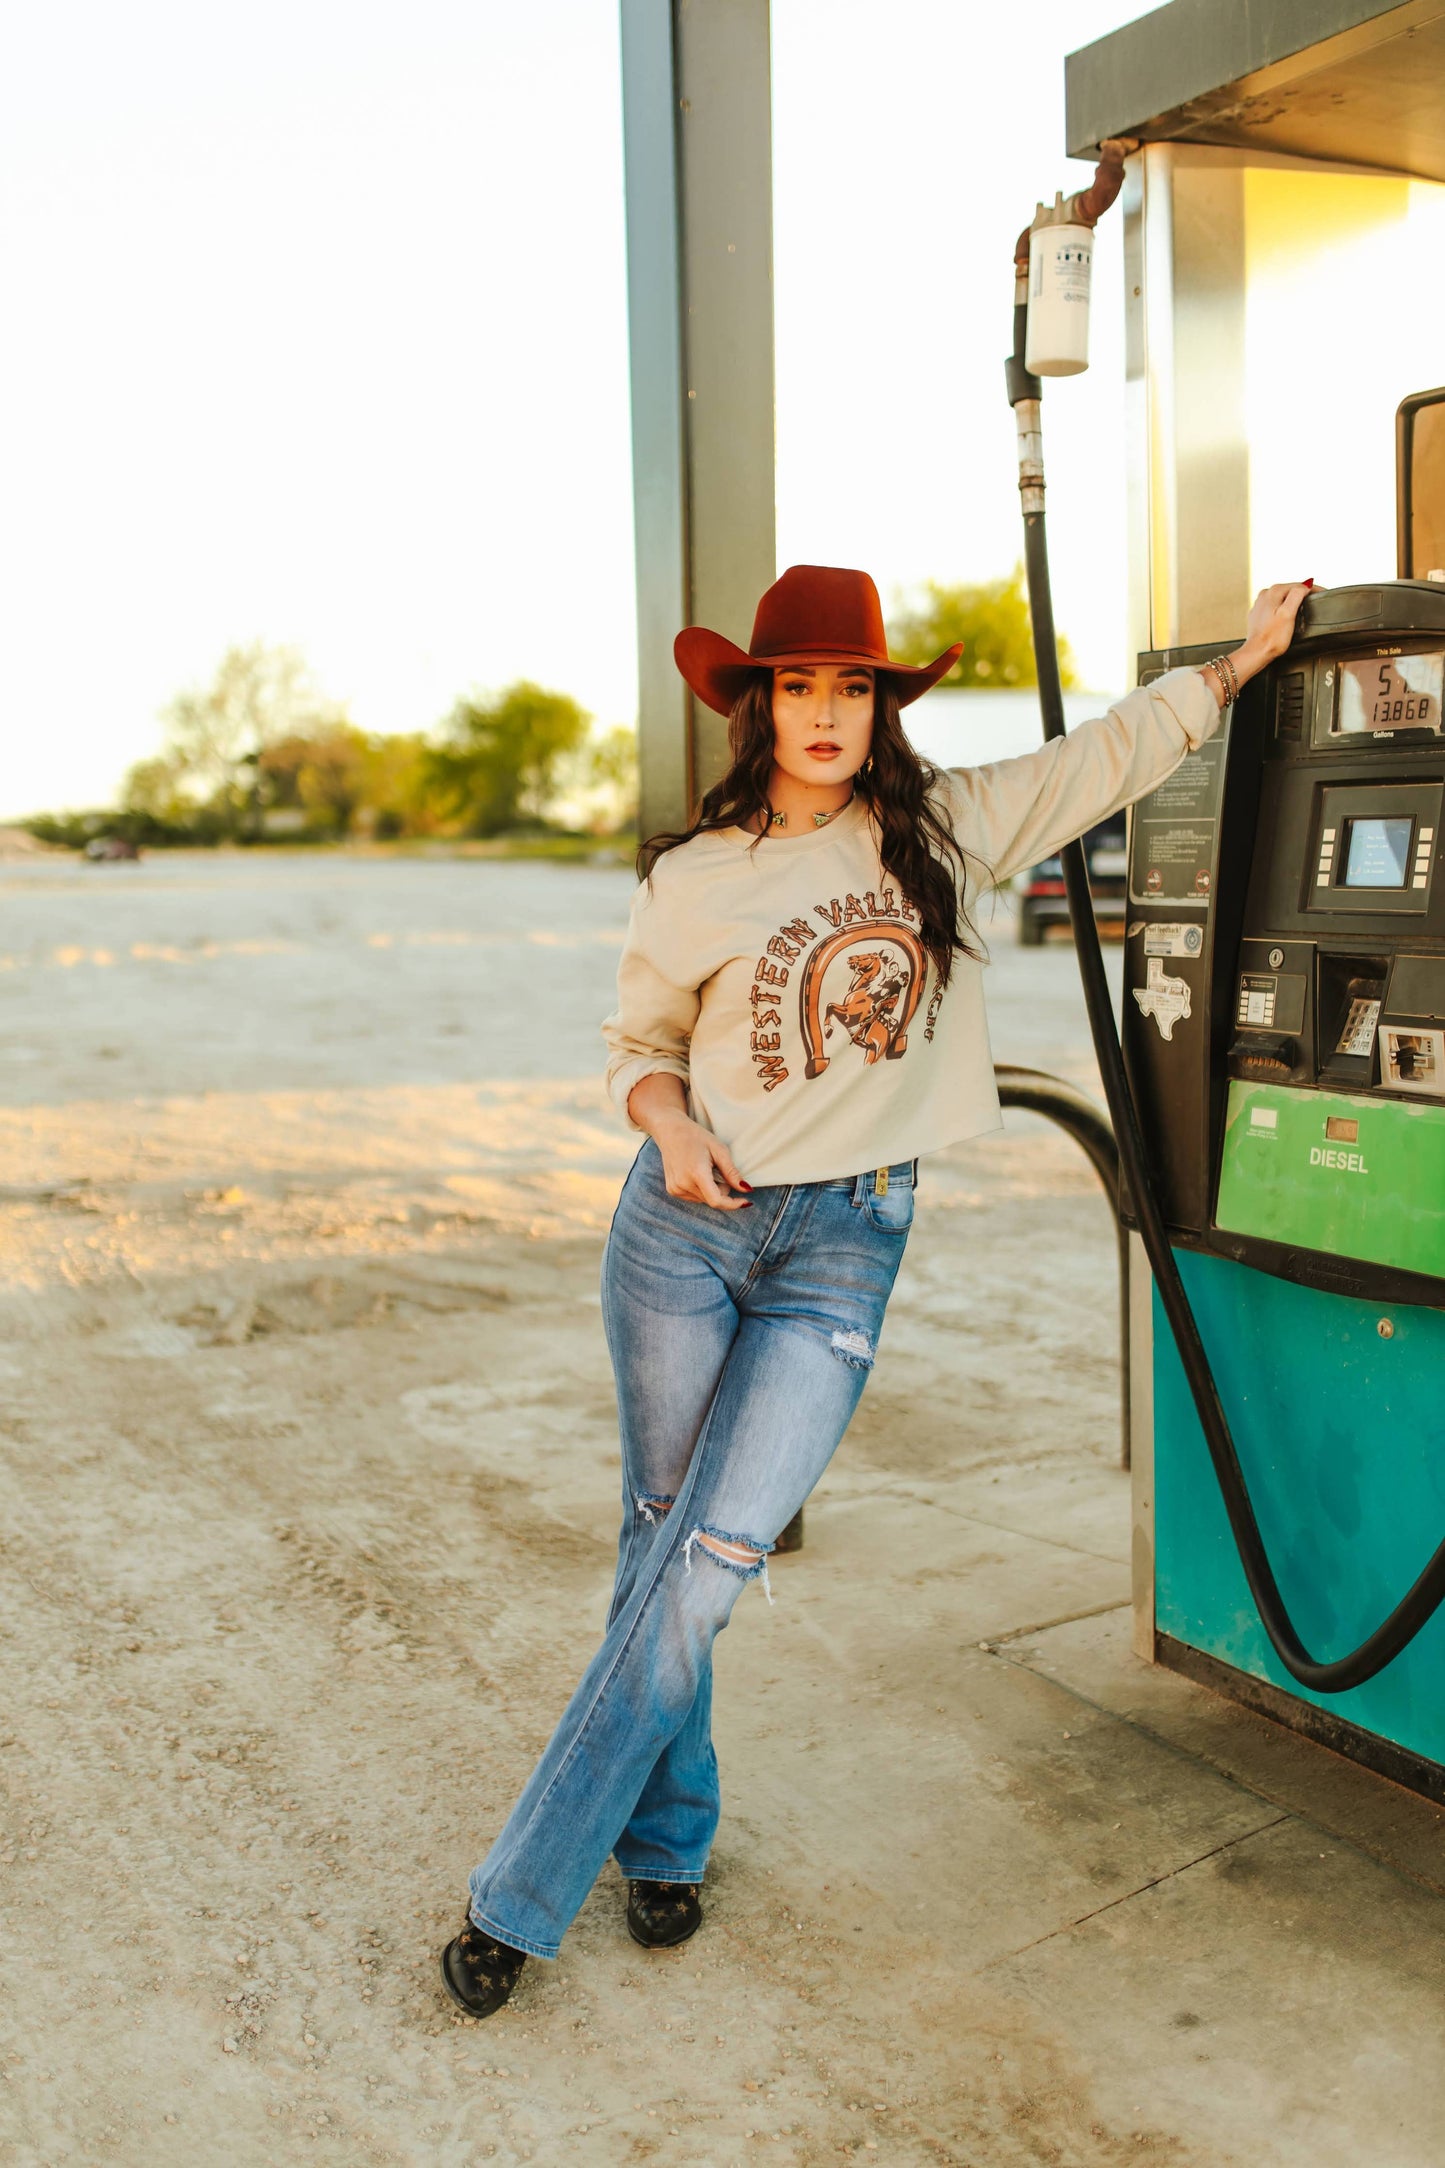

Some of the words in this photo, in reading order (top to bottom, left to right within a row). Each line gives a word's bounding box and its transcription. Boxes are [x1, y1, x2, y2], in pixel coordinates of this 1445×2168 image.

[1325, 670, 1333, 687] $
[1373, 698, 1430, 723] 13.868
[749, 917, 818, 1093] WESTERN
[814, 888, 924, 927] VALLE
[1309, 1147, 1369, 1174] DIESEL
